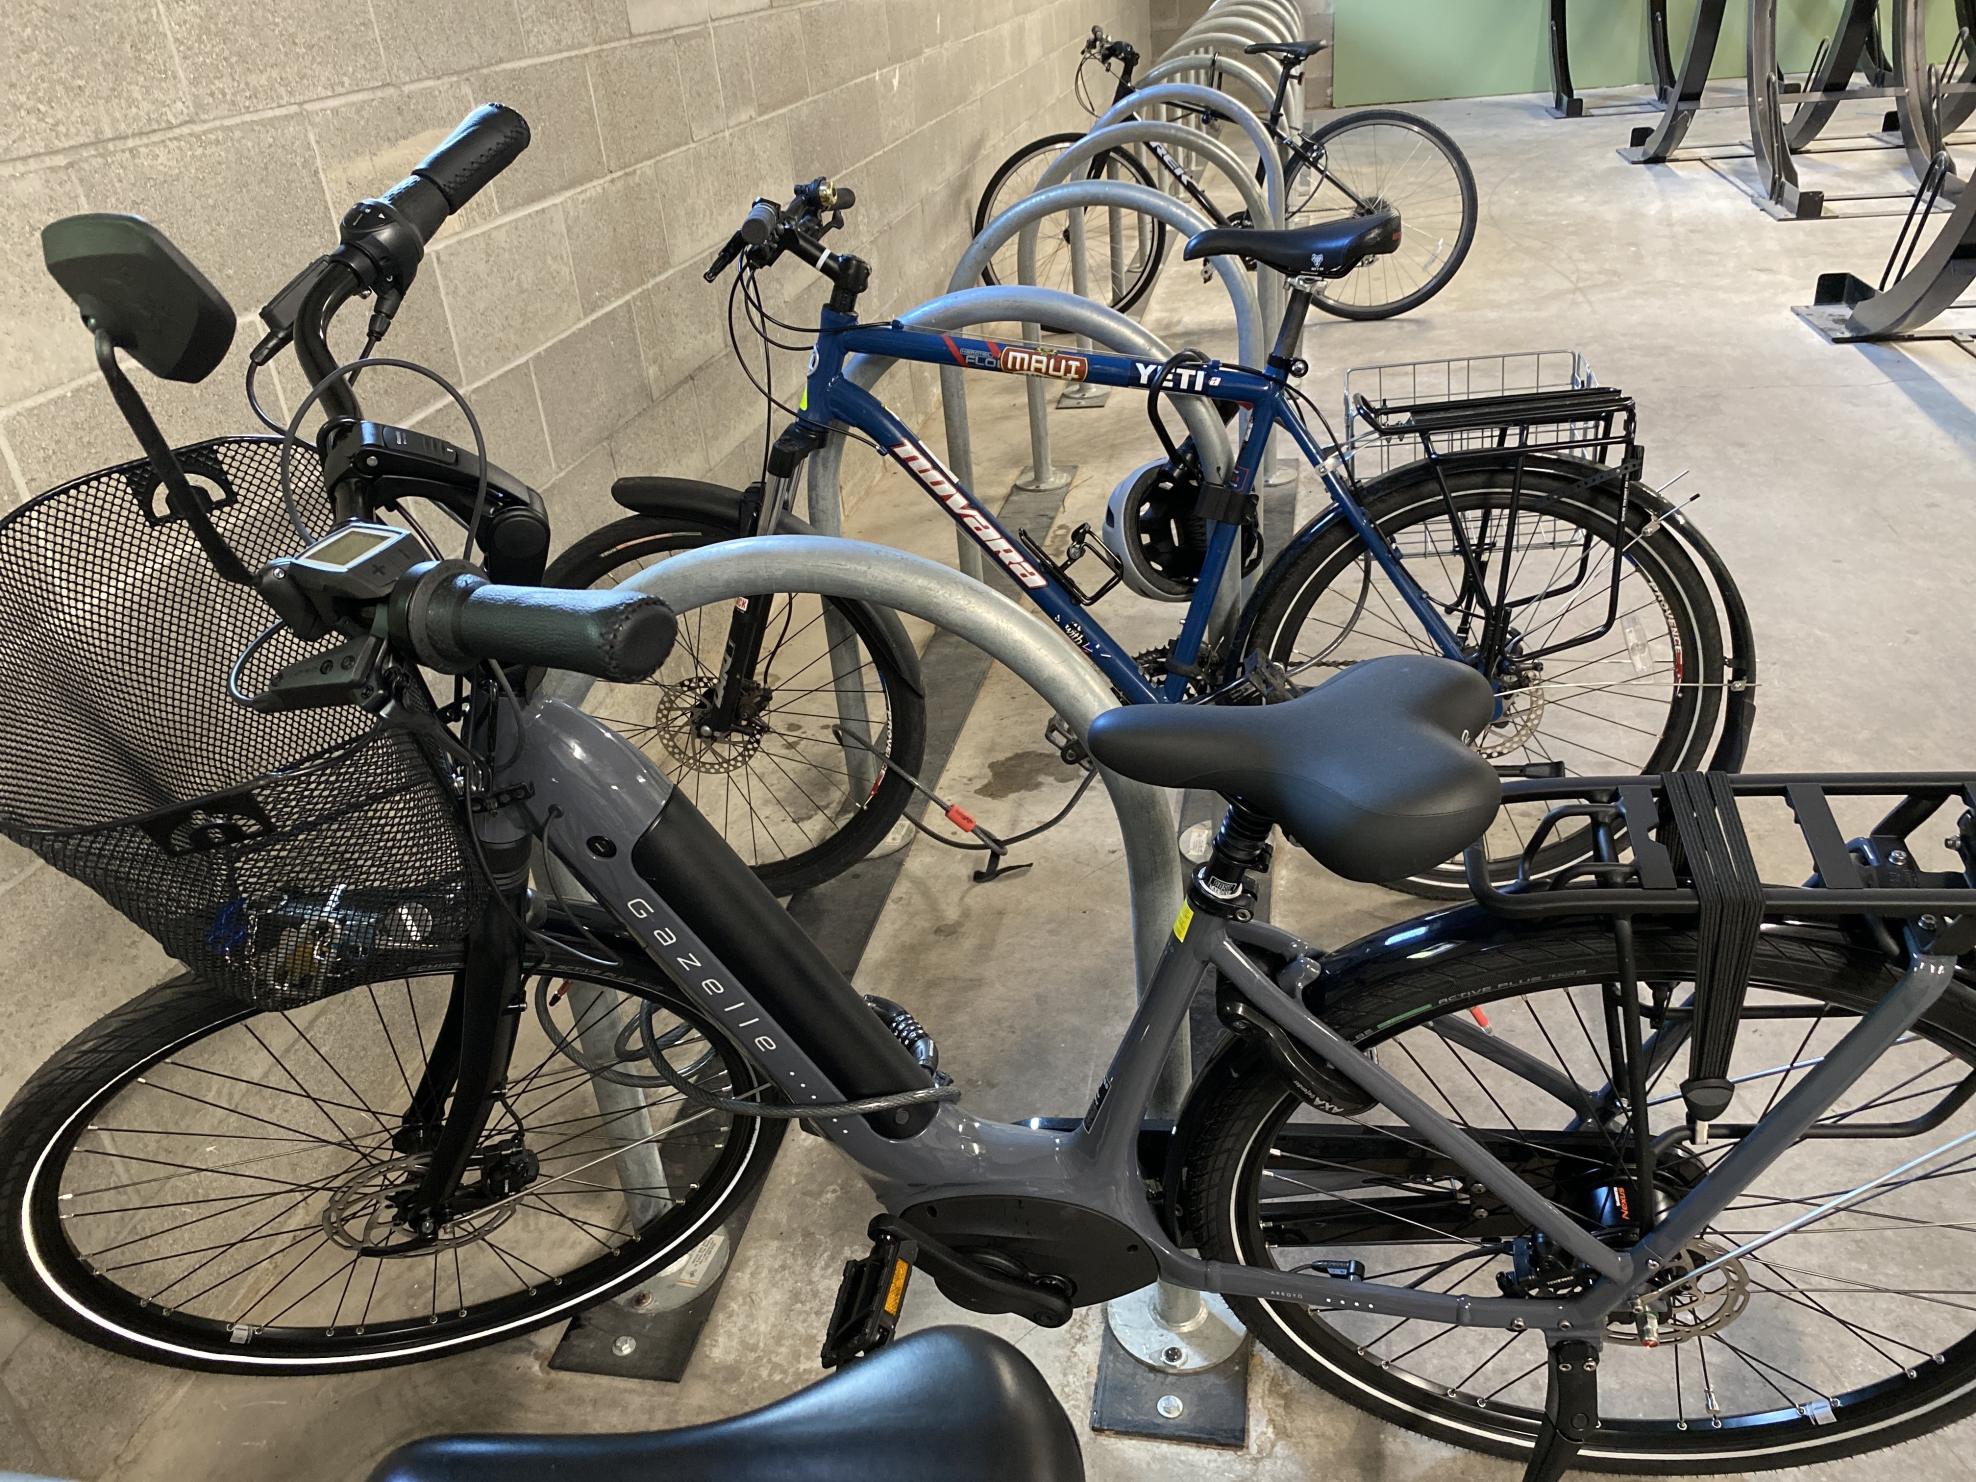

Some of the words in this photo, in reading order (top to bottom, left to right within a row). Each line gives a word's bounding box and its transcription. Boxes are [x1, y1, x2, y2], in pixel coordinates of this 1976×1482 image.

[1149, 141, 1188, 185] REK
[965, 356, 1001, 369] FLO
[1006, 351, 1081, 380] MAUI
[1135, 362, 1205, 391] YETI
[1649, 581, 1683, 655] PROVENCE
[627, 898, 777, 1052] Gazelle
[1438, 985, 1492, 1005] ACTIVE
[1497, 976, 1542, 989] PLUS
[1314, 1097, 1345, 1113] AXA
